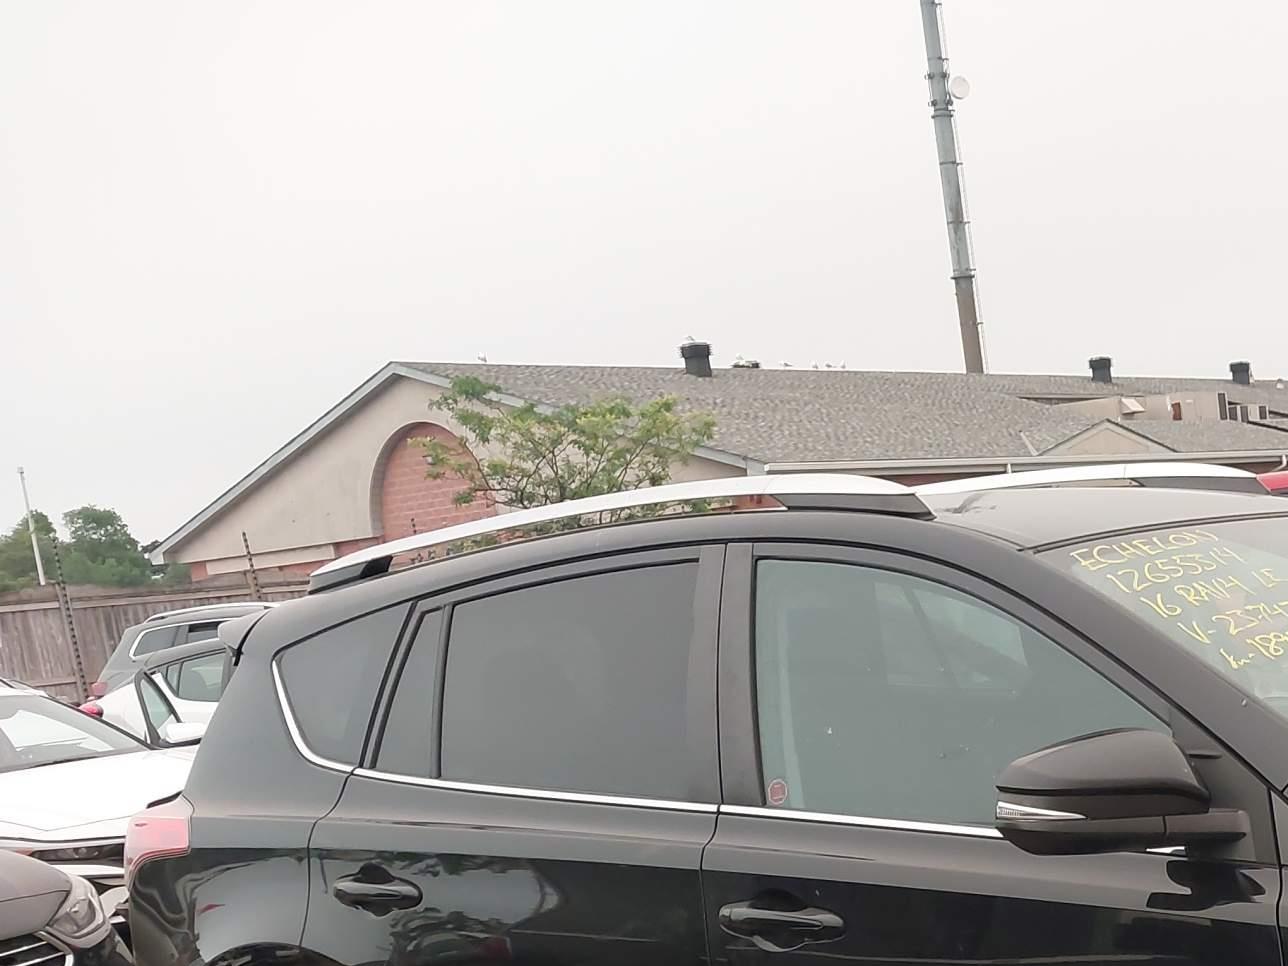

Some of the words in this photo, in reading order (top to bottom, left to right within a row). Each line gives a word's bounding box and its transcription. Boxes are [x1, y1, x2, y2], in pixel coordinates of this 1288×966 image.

[1069, 529, 1219, 571] ECHELON
[1106, 546, 1249, 593] 12655314
[1139, 592, 1183, 618] 16
[1174, 575, 1256, 606] RAV4
